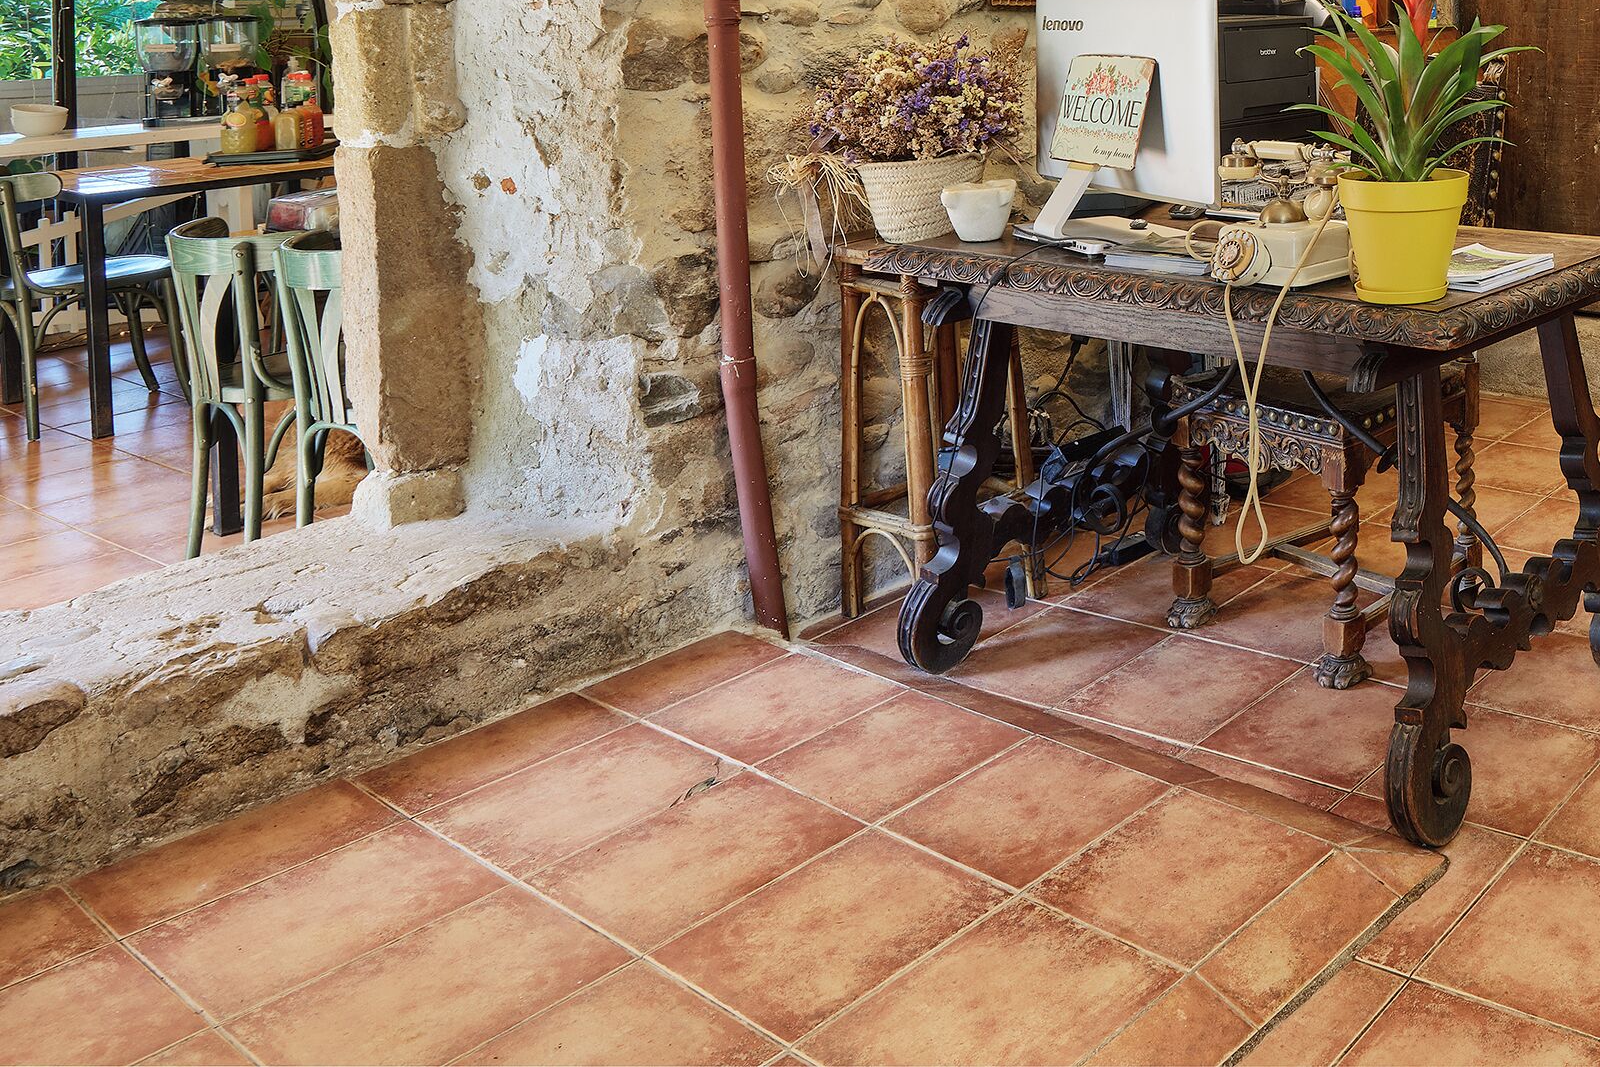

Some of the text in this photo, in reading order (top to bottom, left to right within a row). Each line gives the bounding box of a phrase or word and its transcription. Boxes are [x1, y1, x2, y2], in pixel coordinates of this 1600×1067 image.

[1042, 16, 1084, 32] lenovo
[1259, 48, 1277, 56] brother
[1062, 94, 1142, 129] WELCOME
[1092, 147, 1132, 160] to my home
